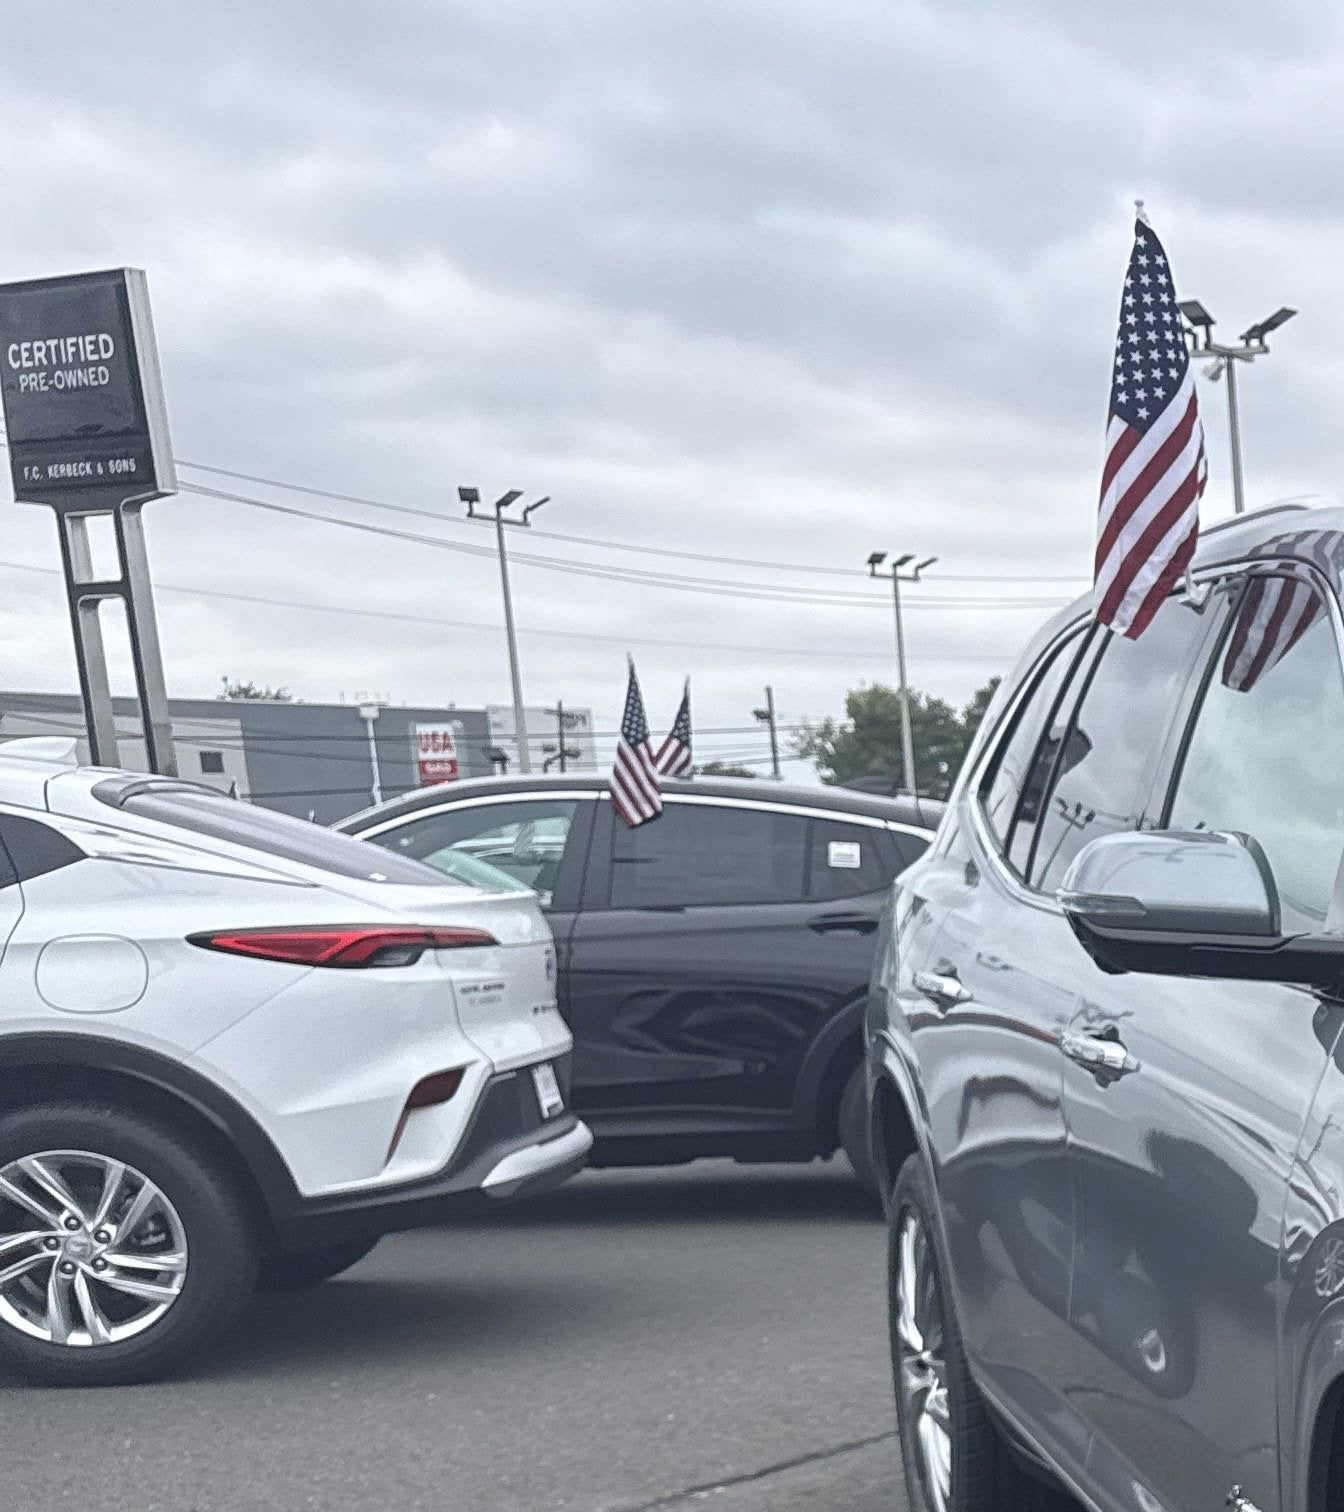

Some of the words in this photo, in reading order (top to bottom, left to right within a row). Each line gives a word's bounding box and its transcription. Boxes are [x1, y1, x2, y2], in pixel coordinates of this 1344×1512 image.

[8, 333, 114, 369] CERTIFIED
[19, 366, 110, 393] PRE-OWNED
[47, 459, 93, 479] KERBECK
[108, 456, 137, 474] SONS
